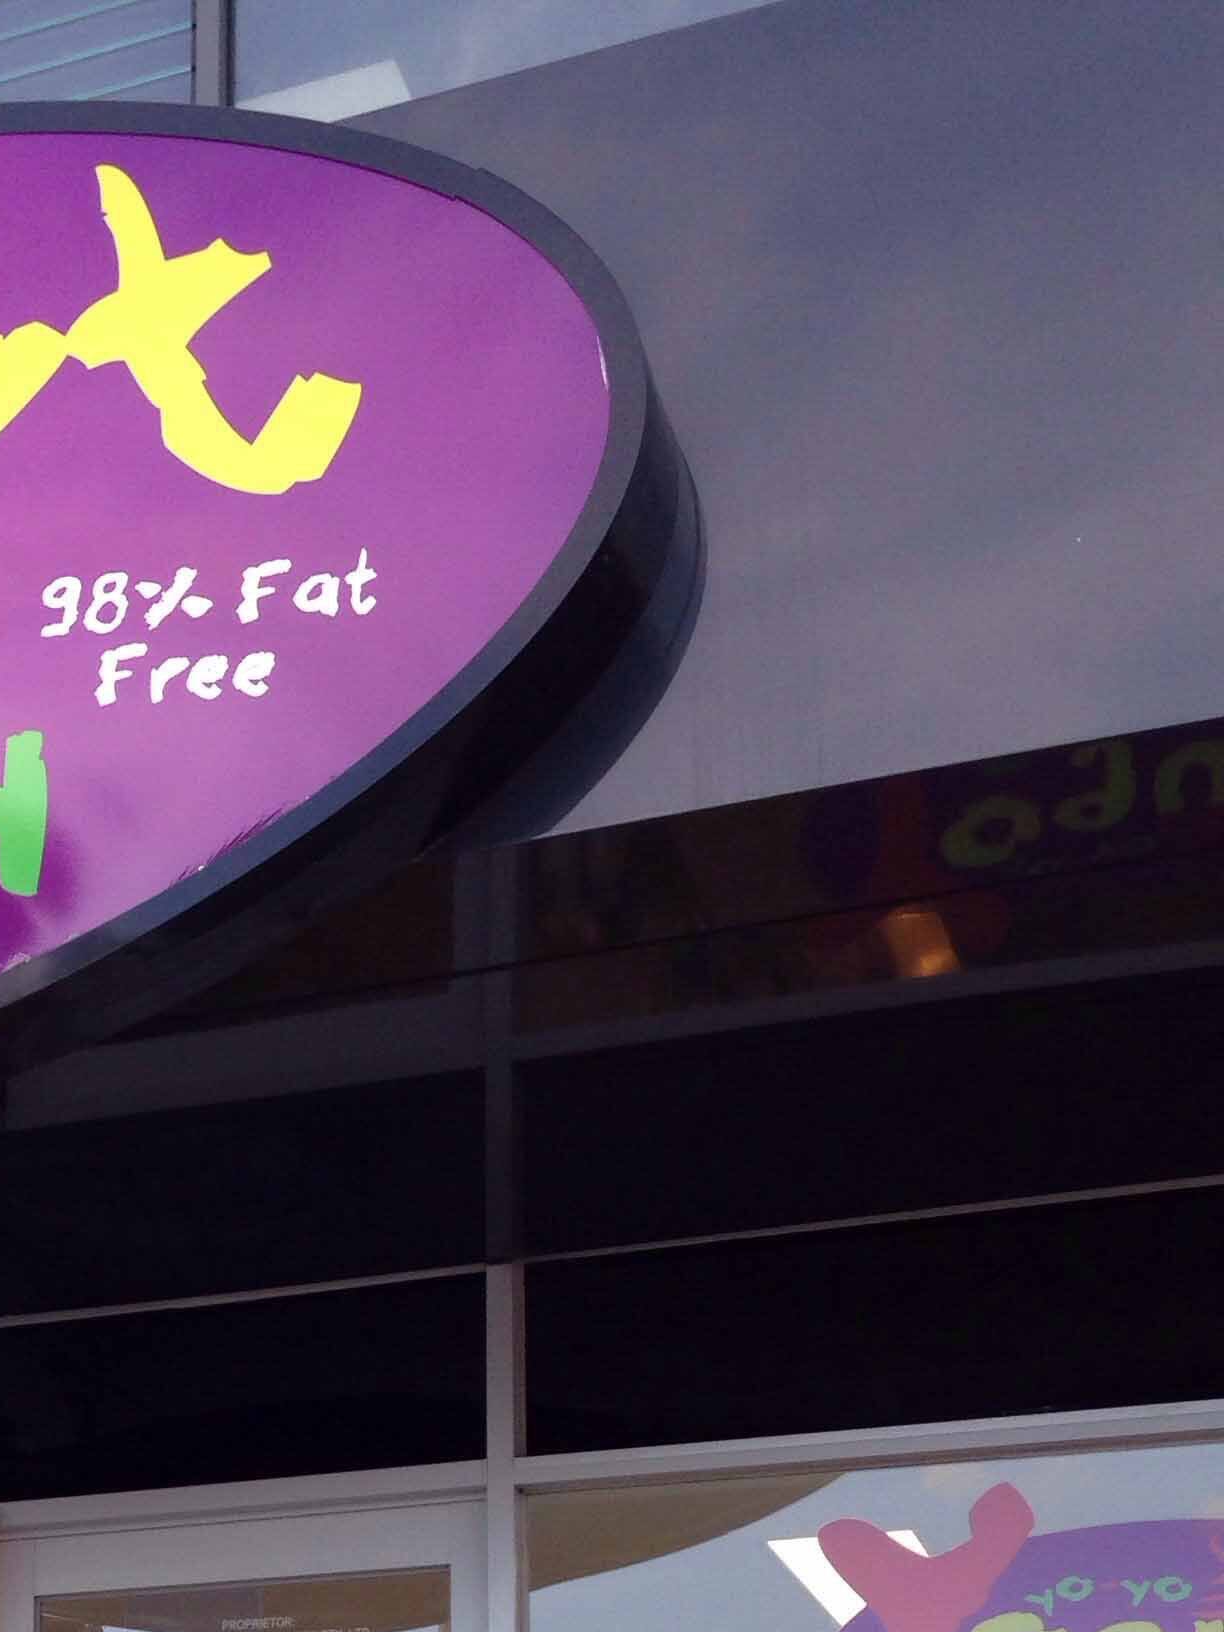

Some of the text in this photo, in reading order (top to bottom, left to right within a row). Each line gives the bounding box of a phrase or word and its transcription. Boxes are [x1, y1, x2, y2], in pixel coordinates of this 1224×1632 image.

[40, 548, 379, 638] 98% Fat
[95, 643, 277, 707] Free
